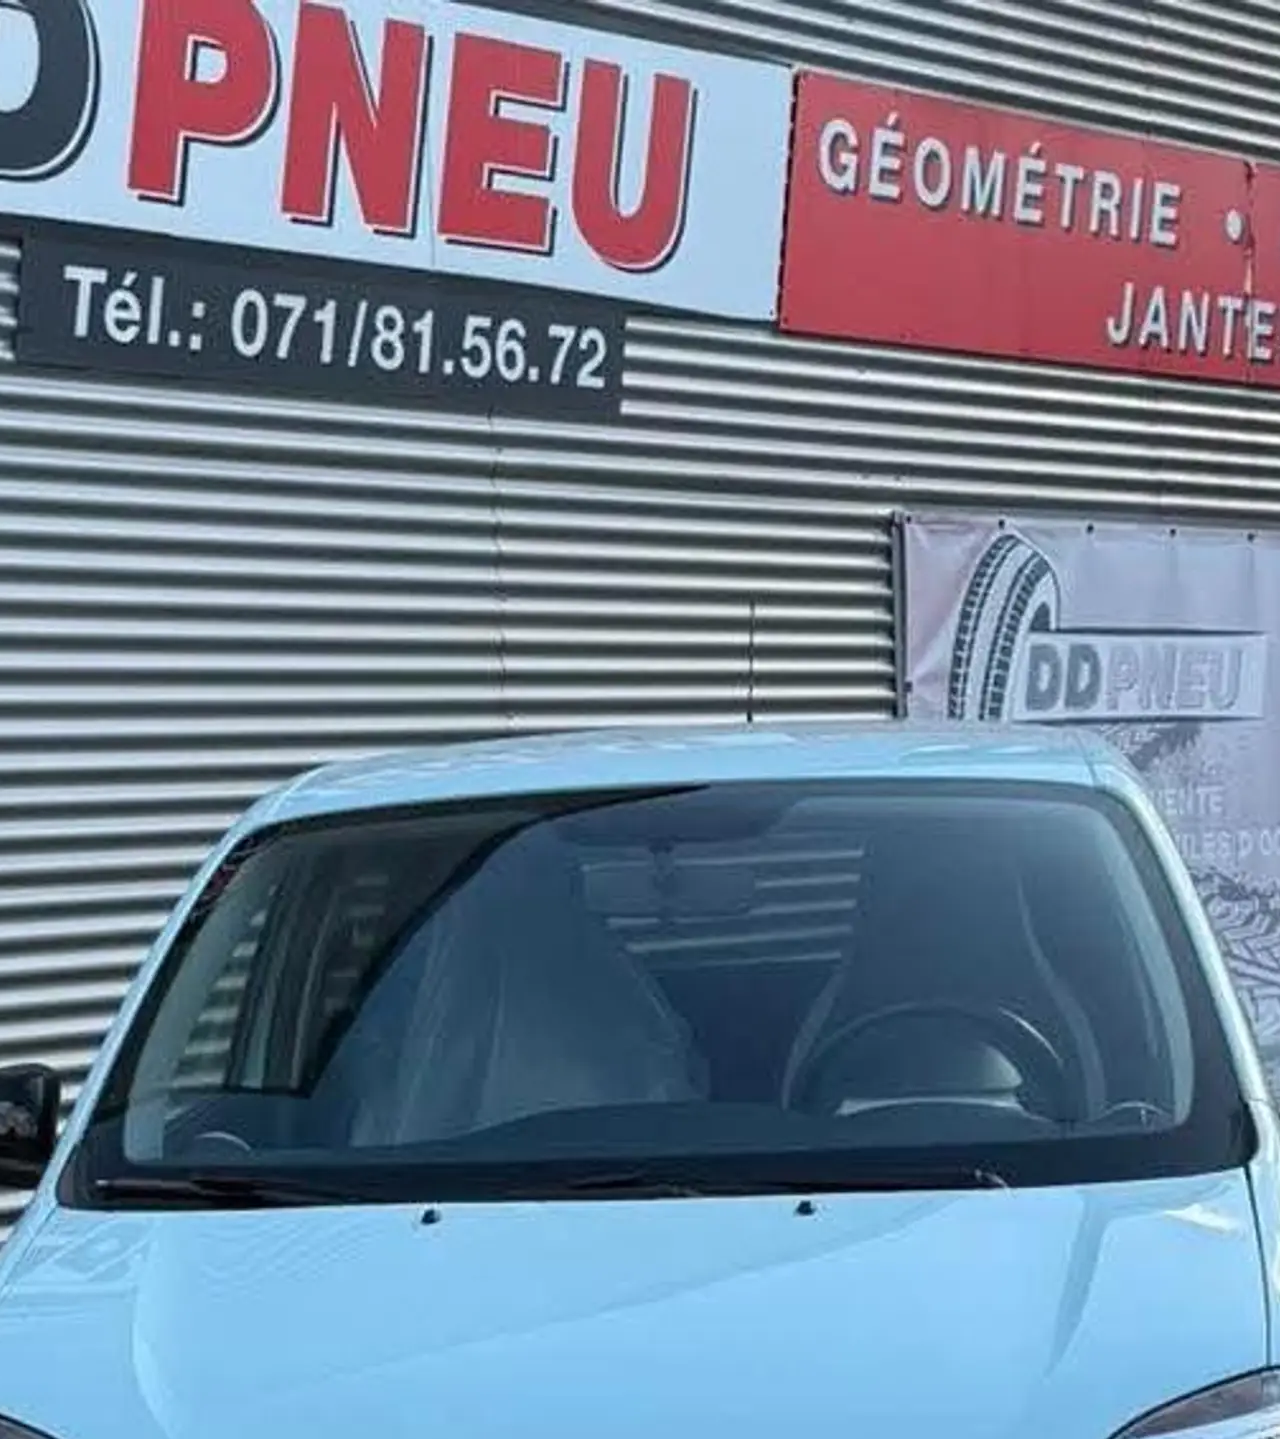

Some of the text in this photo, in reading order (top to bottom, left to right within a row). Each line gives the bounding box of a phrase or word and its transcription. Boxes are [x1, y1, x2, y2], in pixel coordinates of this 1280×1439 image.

[819, 111, 1182, 246] GÉOMÉTRIE
[62, 264, 607, 390] Tél.: 071/81.56.72
